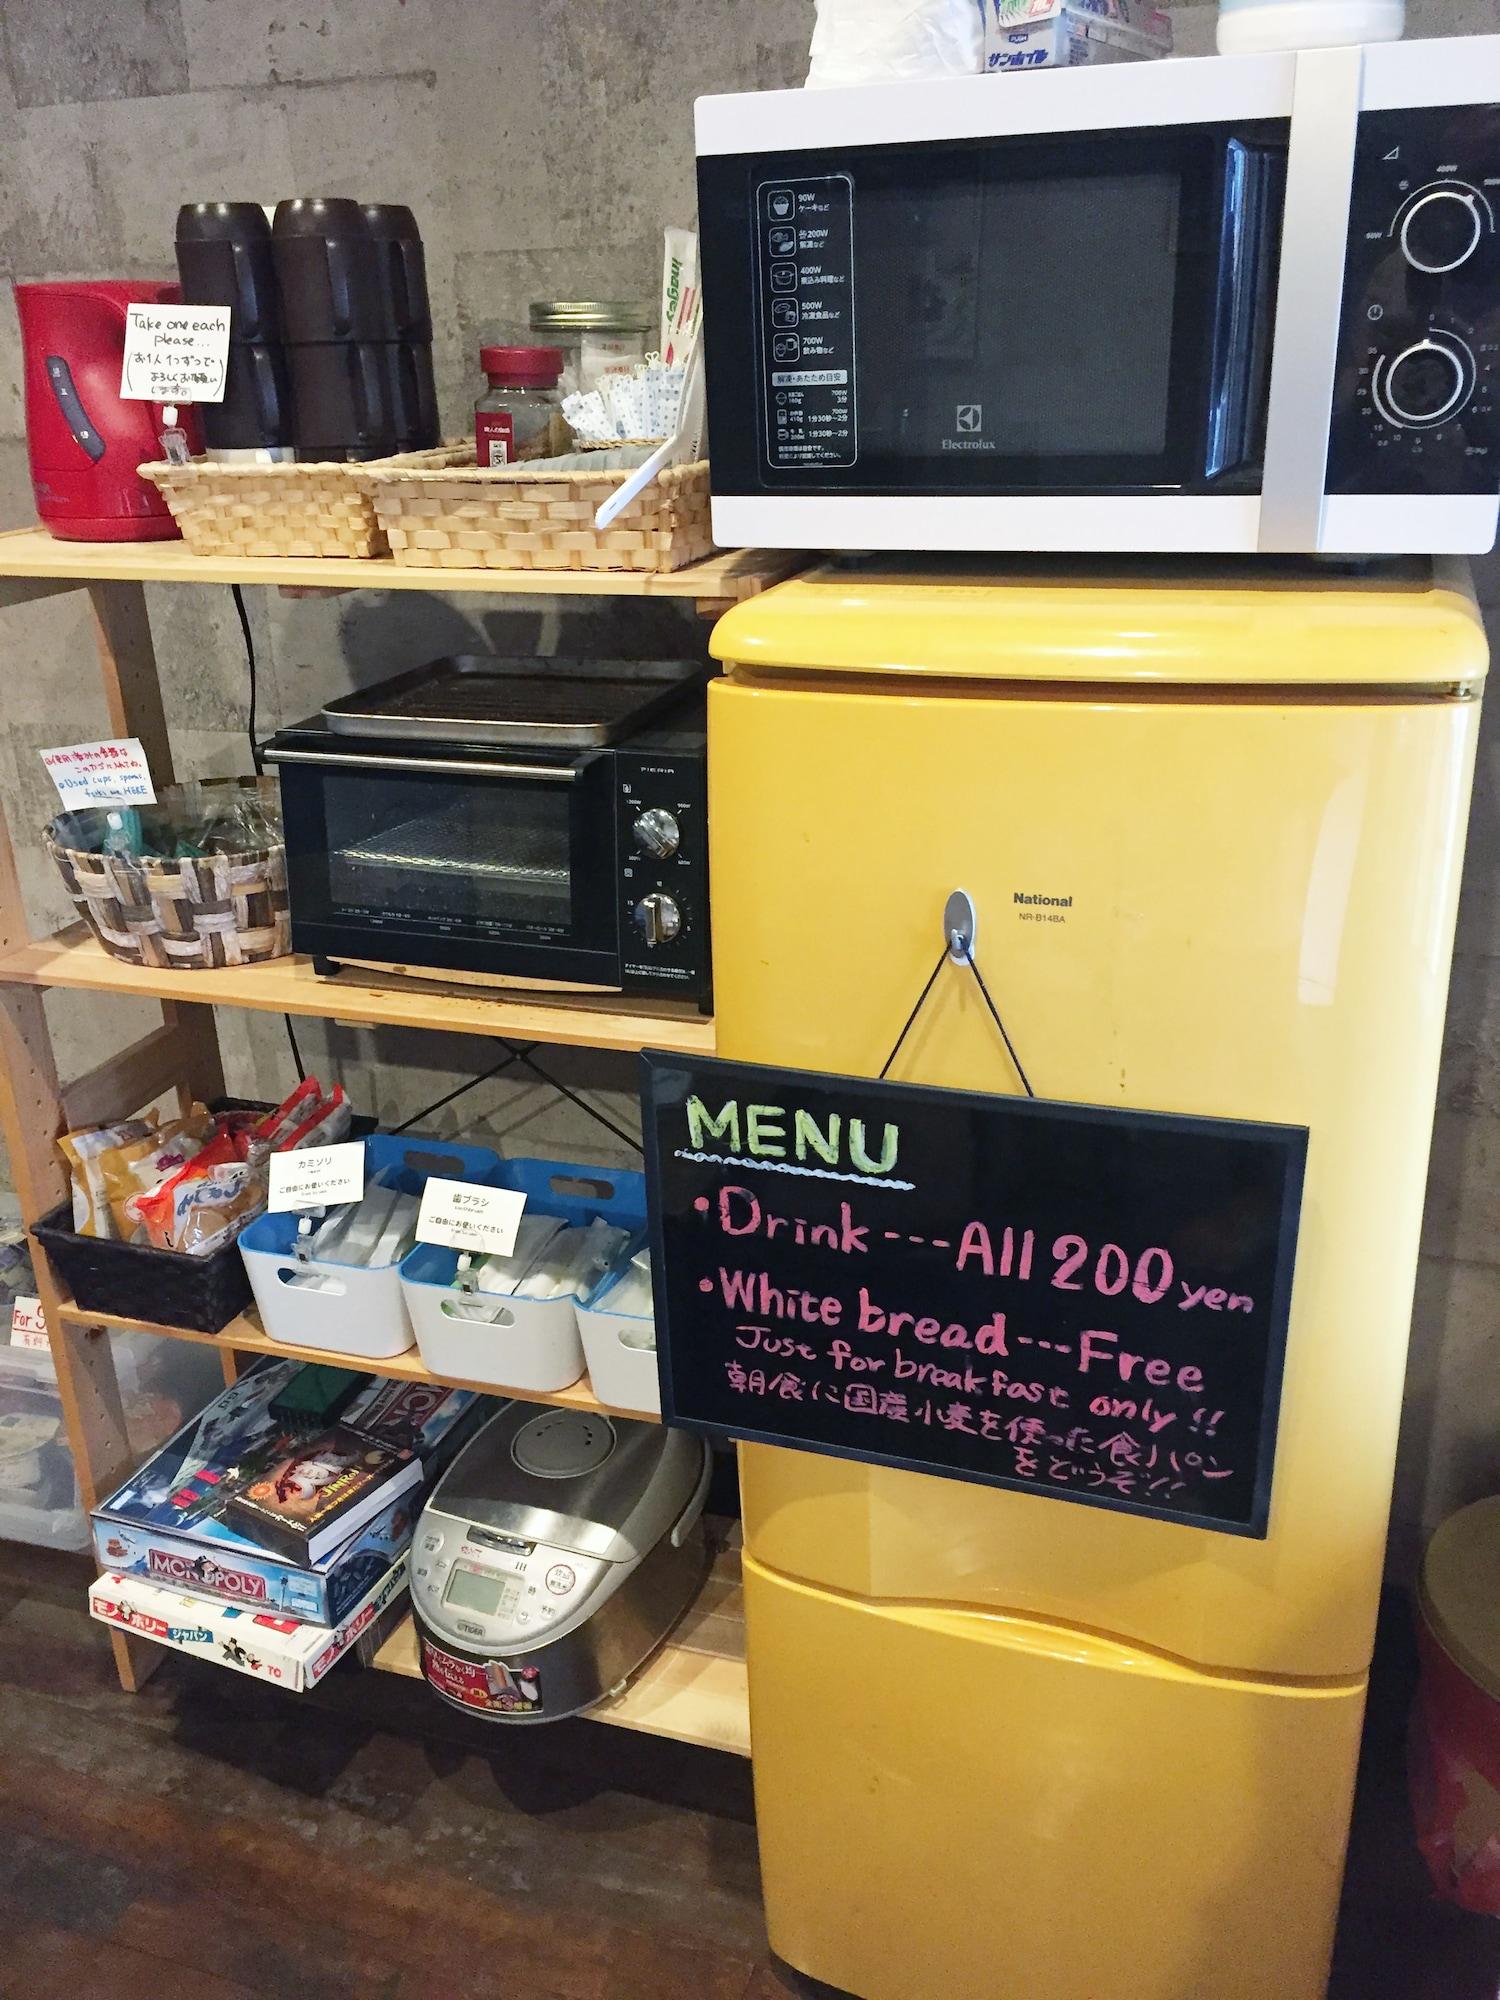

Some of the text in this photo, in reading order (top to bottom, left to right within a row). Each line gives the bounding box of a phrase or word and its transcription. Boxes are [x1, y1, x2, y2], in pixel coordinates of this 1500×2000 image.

[989, 49, 1049, 67] サンホイル
[798, 193, 816, 203] 90W
[798, 203, 830, 213] ケーキなど
[808, 229, 829, 239] 200W
[800, 266, 822, 275] 400W
[801, 301, 823, 311] 500W
[129, 312, 226, 332] Take one each
[803, 336, 824, 345] 700W
[777, 373, 842, 383] 解凍・あたため目安
[942, 439, 996, 450] Electrolux
[66, 776, 89, 789] Used
[124, 785, 148, 796] HERE
[1013, 892, 1073, 908] National
[685, 1094, 899, 1174] MENU
[298, 1156, 333, 1169] カミソリ
[279, 1178, 351, 1194] ご自由にお使いください
[452, 1192, 490, 1208] 歯ブラシ
[428, 1215, 504, 1235] ご自由にお使いください
[718, 1185, 870, 1254] Drink
[956, 1220, 1035, 1281] All
[1050, 1234, 1175, 1305] 200
[1177, 1281, 1255, 1314] yen
[13, 1304, 47, 1330] For S
[719, 1266, 842, 1327] White
[858, 1286, 1009, 1357] bread
[1078, 1329, 1205, 1393] Free
[735, 1325, 817, 1361] Just
[826, 1338, 887, 1371] for
[1088, 1395, 1179, 1434] only
[724, 1358, 1235, 1479] 朝食に国産小麦を使った食パン
[172, 1628, 209, 1643] ジャパン
